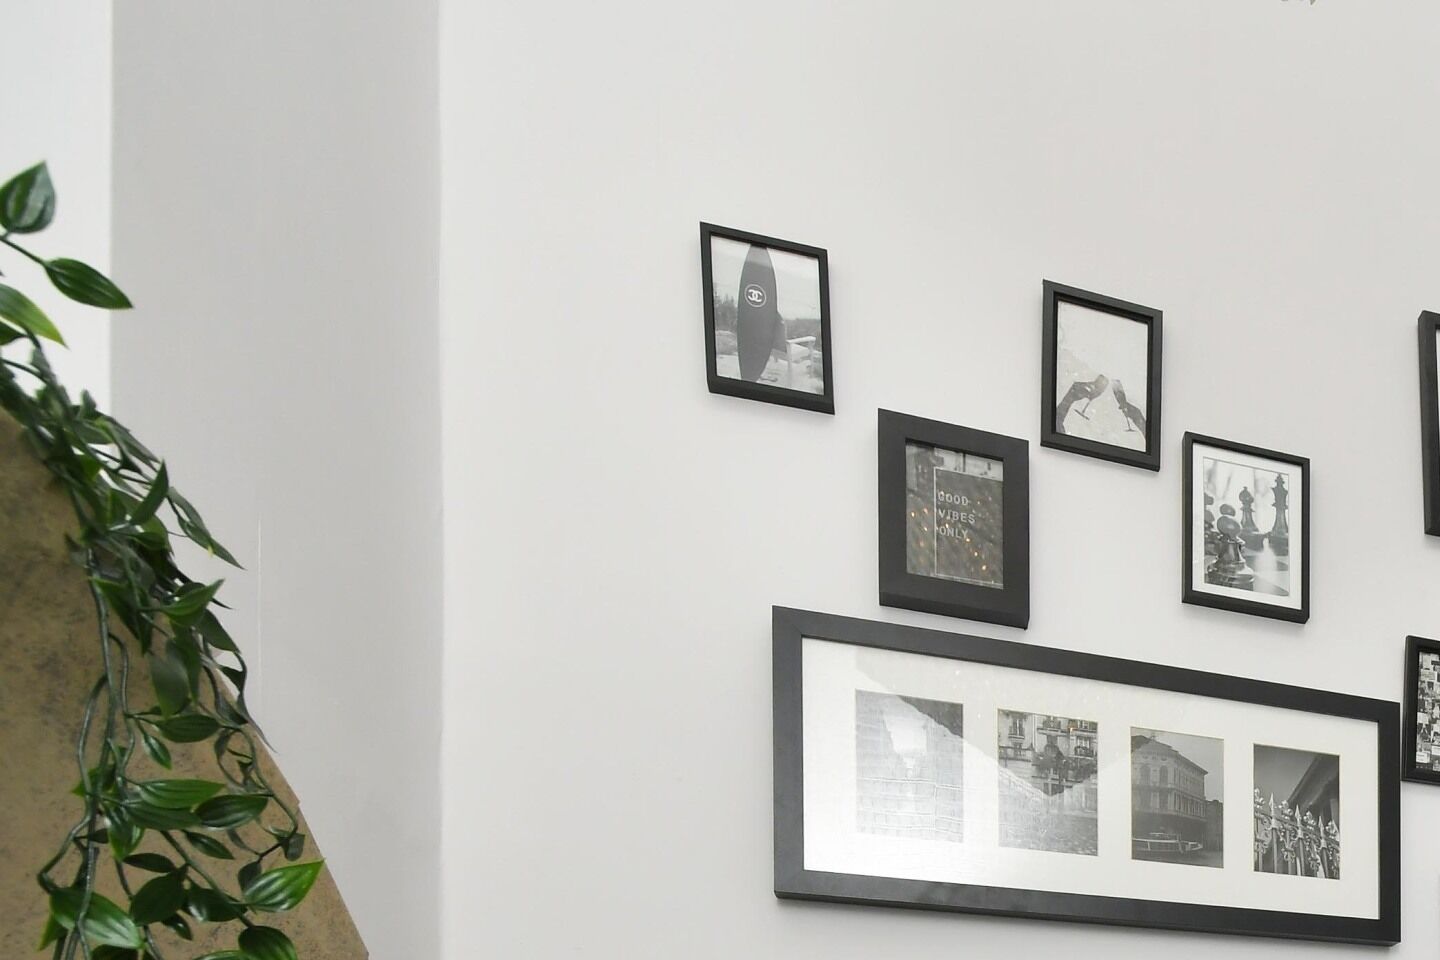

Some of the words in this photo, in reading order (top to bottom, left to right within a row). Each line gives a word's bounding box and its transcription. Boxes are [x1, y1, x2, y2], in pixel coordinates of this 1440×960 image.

[938, 491, 970, 506] GOOD
[939, 508, 976, 525] VIBES
[939, 524, 969, 540] ONLY
